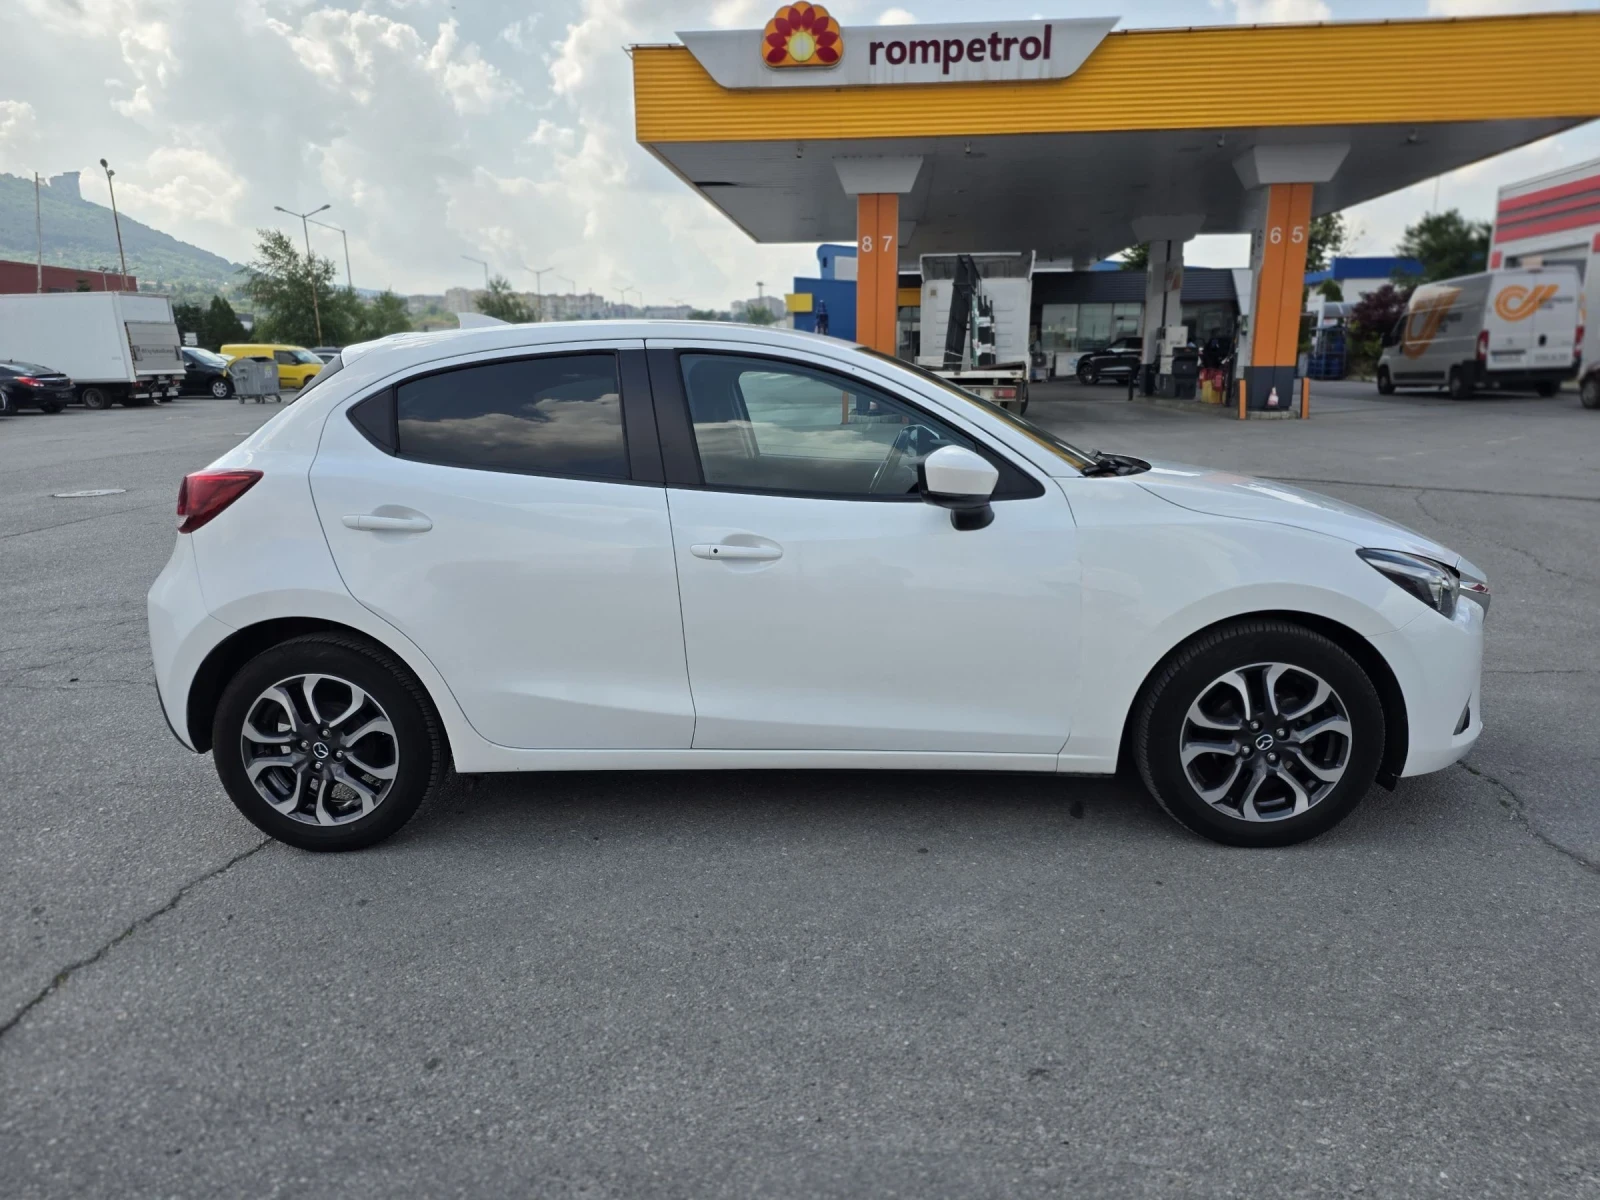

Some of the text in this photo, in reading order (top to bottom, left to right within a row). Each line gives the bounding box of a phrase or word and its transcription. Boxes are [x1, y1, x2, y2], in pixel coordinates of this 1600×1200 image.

[869, 24, 1052, 75] rompetrol
[861, 235, 893, 253] 8 7
[1270, 226, 1304, 244] 6 5
